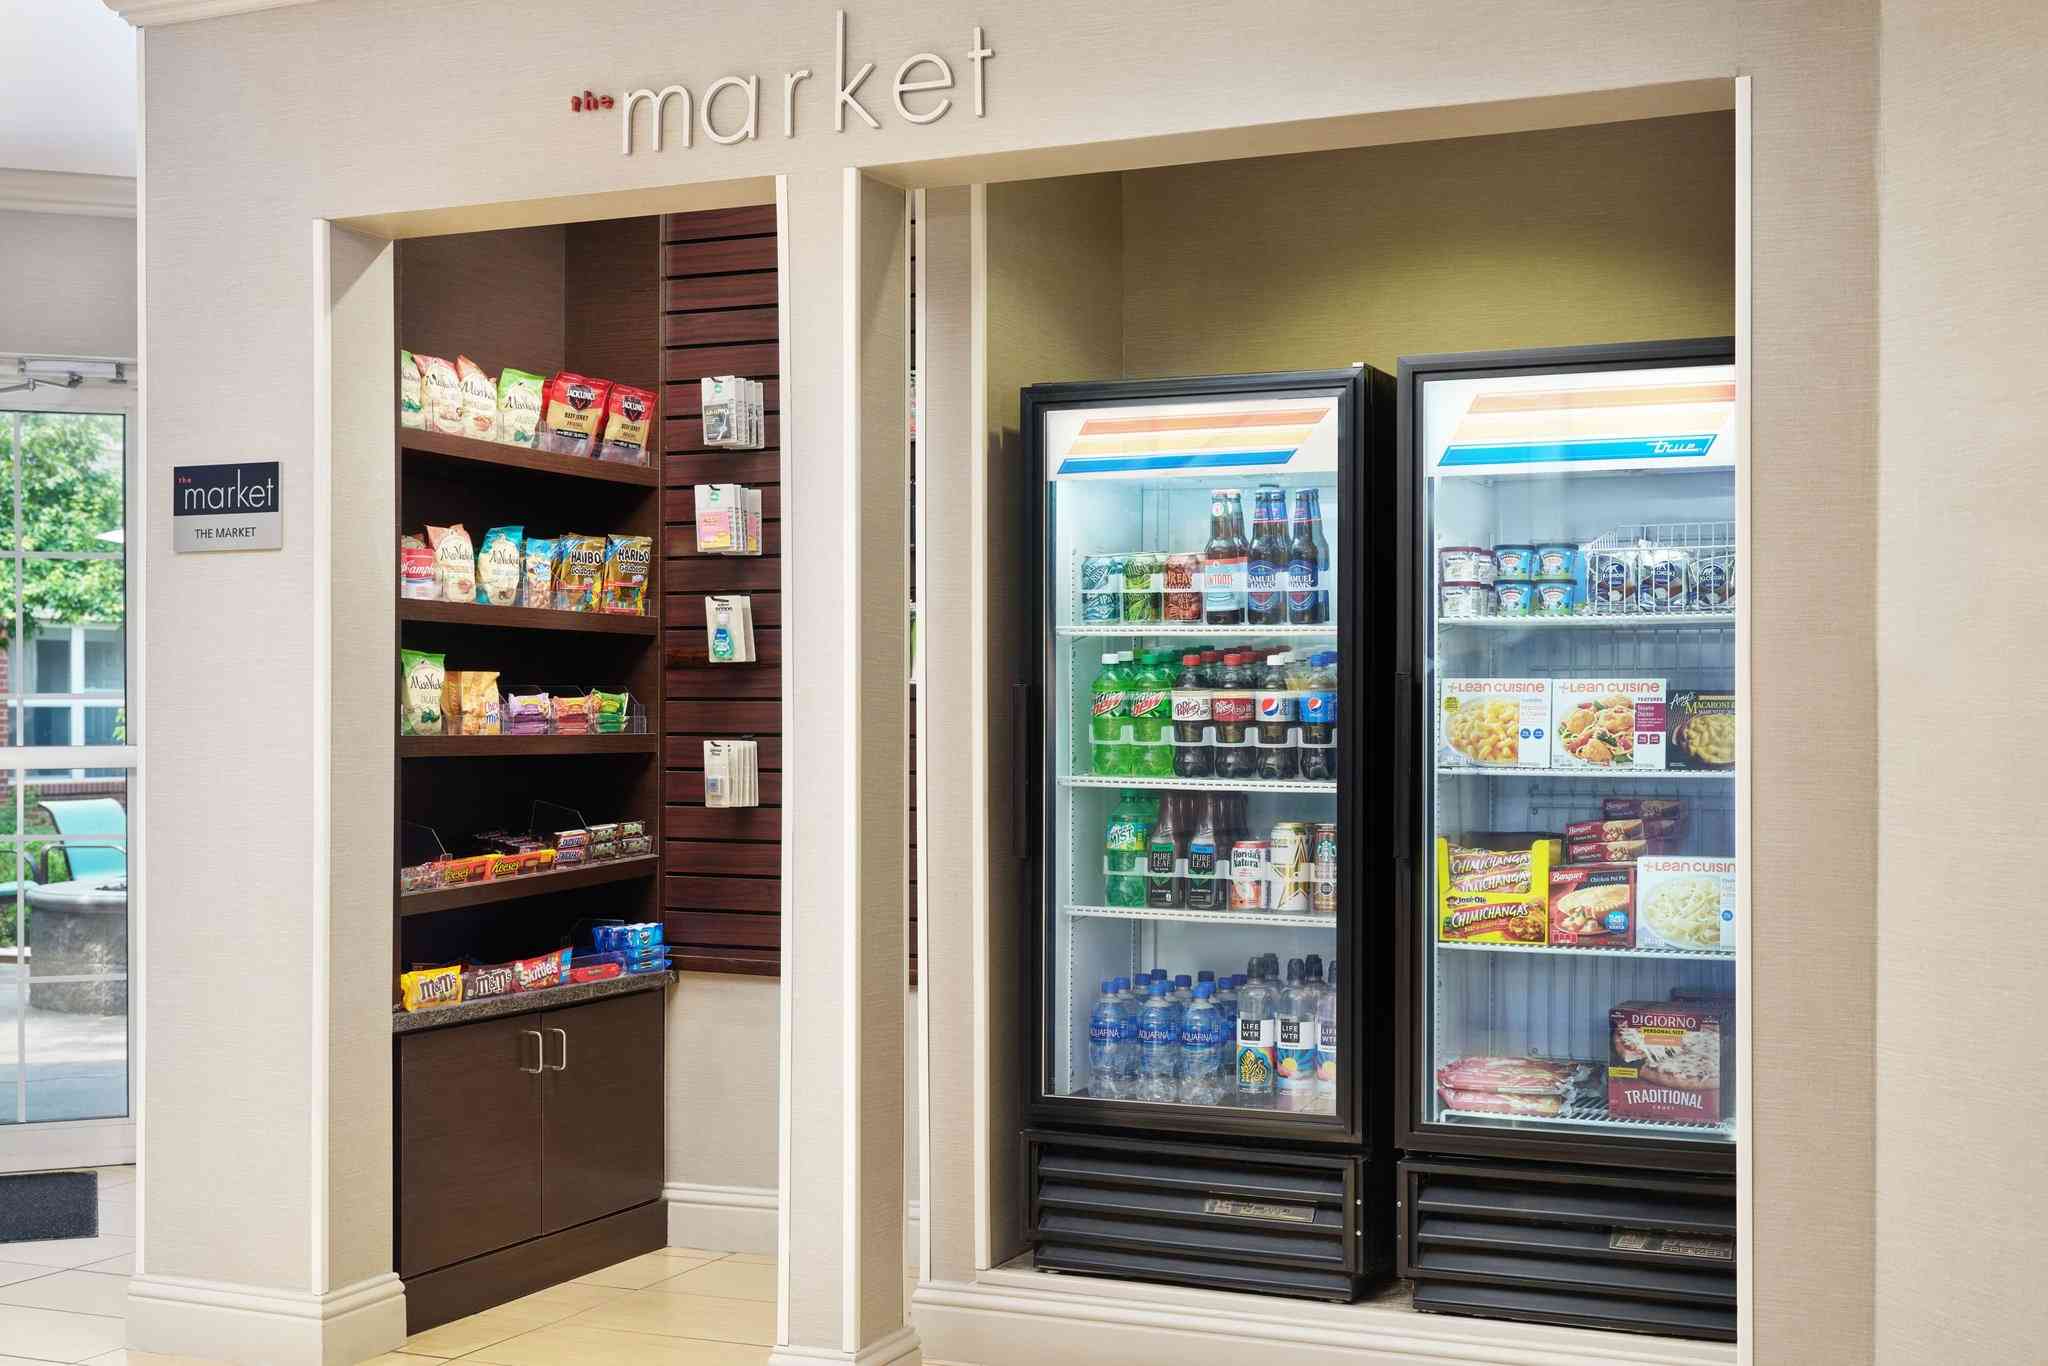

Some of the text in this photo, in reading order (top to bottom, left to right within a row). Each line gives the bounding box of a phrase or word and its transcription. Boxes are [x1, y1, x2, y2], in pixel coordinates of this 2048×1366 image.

[570, 8, 995, 156] the market
[184, 469, 274, 510] market
[194, 527, 257, 539] THE MARKET
[618, 545, 650, 562] HARIBO
[1452, 904, 1529, 928] CHIMICHANGAS
[520, 961, 559, 986] Skittles
[1090, 1028, 1121, 1038] AQUAFINA
[1138, 1030, 1168, 1040] AQUAFINA
[1242, 1023, 1260, 1031] LIFE
[1182, 1031, 1213, 1041] AQUAFINA
[1625, 1089, 1704, 1110] TRADITIONAL
